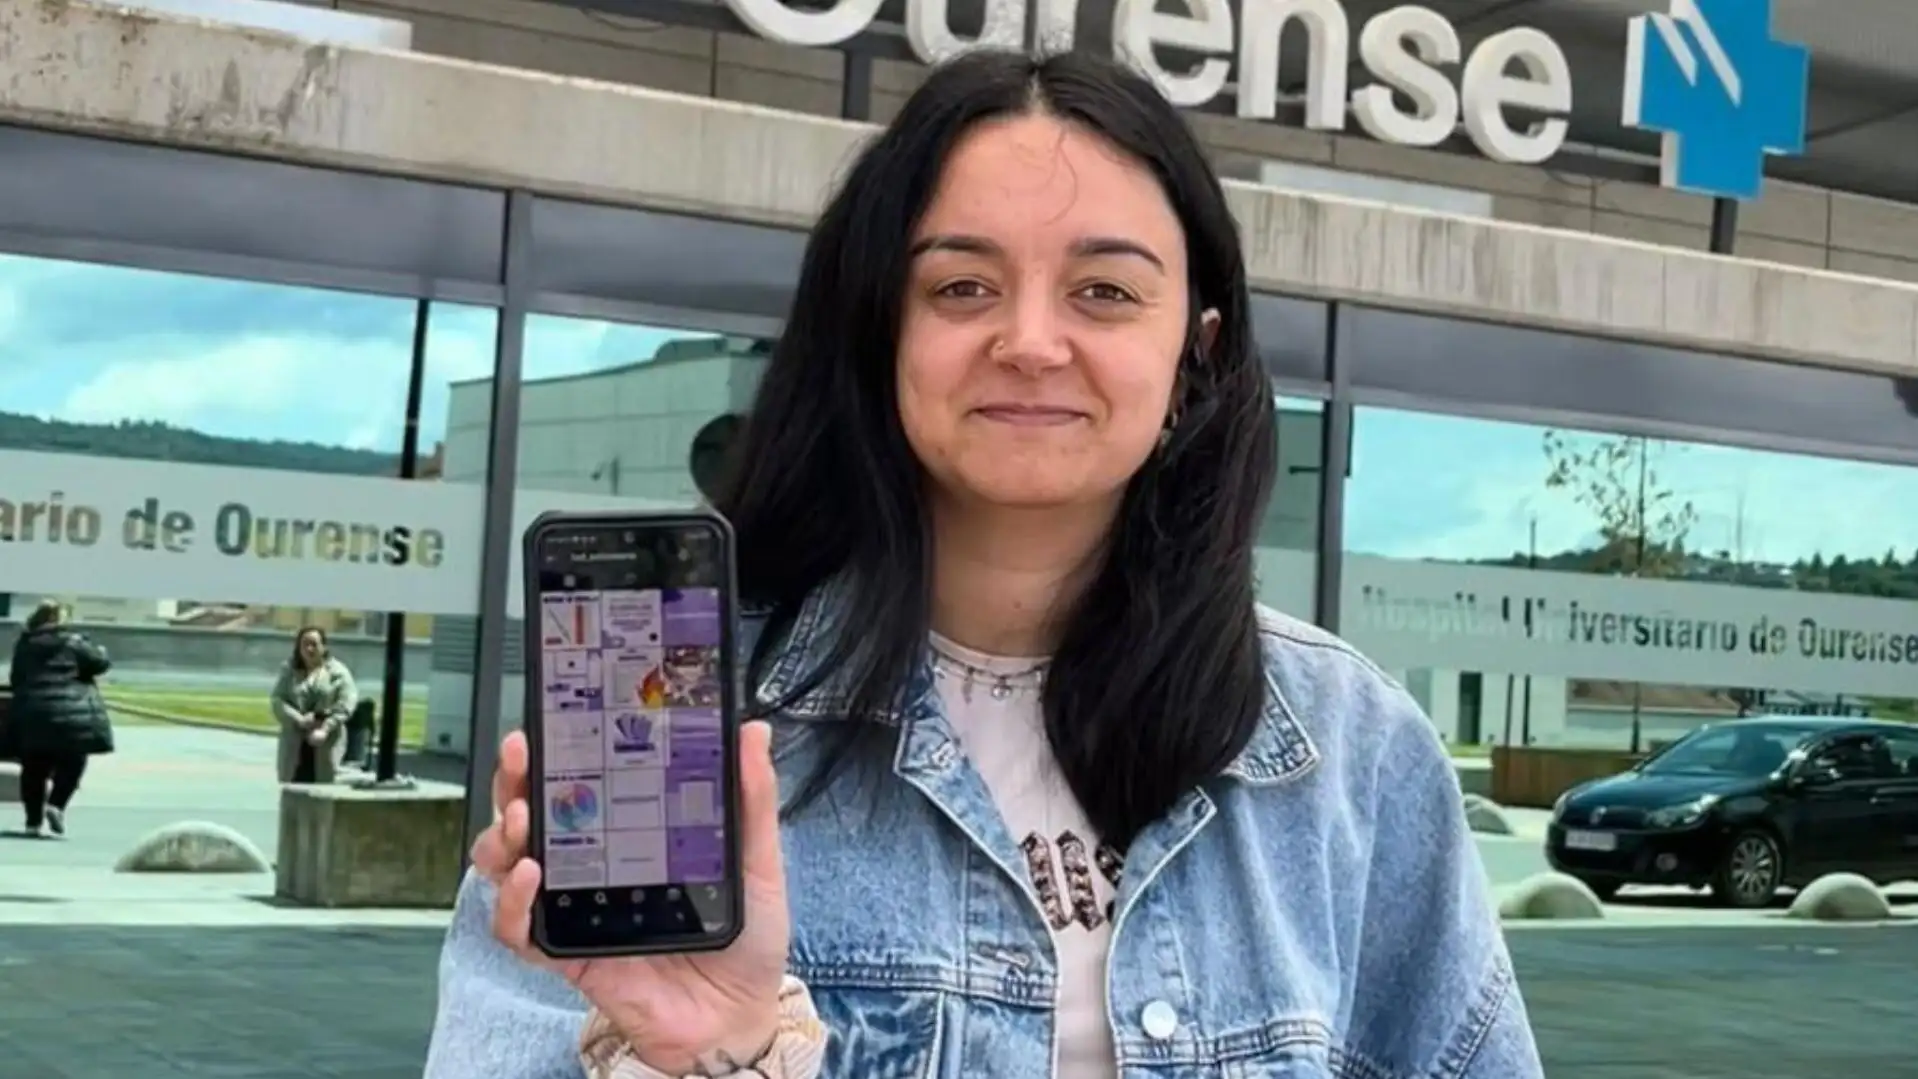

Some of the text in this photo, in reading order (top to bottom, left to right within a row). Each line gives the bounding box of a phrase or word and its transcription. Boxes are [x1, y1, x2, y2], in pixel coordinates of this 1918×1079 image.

[123, 498, 194, 553] de
[215, 502, 444, 568] Ourense
[1749, 614, 1787, 656] de
[1798, 617, 1918, 664] Ourense
